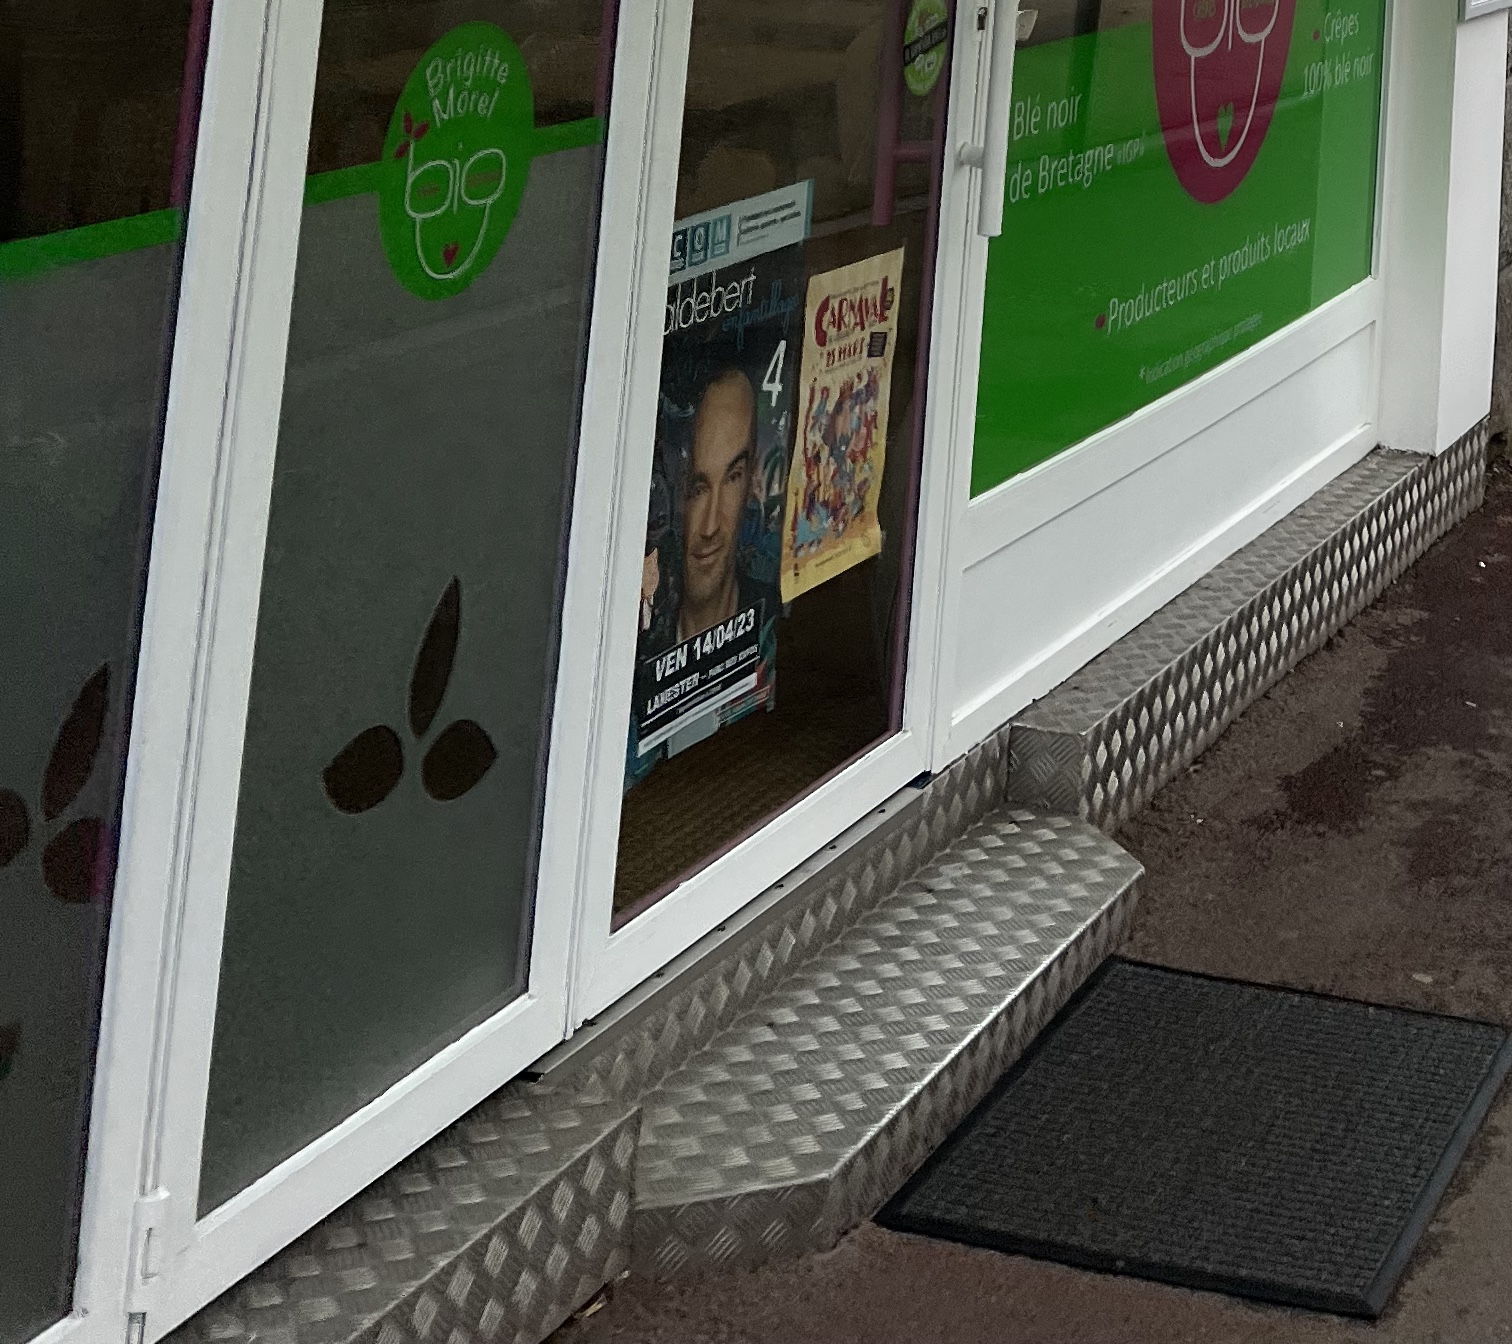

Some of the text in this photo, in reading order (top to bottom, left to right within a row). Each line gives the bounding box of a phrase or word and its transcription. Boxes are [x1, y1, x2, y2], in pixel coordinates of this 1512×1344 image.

[1324, 9, 1359, 45] Crêpes
[425, 44, 510, 96] Brigitte
[1303, 47, 1374, 96] 100% blé noir
[432, 83, 499, 128] Morel
[1013, 85, 1083, 140] Blé noir
[1009, 160, 1032, 203] de
[1037, 143, 1114, 194] Bretagne
[1108, 218, 1310, 336] Producteurs et produits locaux
[762, 339, 787, 407] 4
[655, 608, 755, 682] VEN 14/04/23
[647, 672, 699, 716] LANESTER
